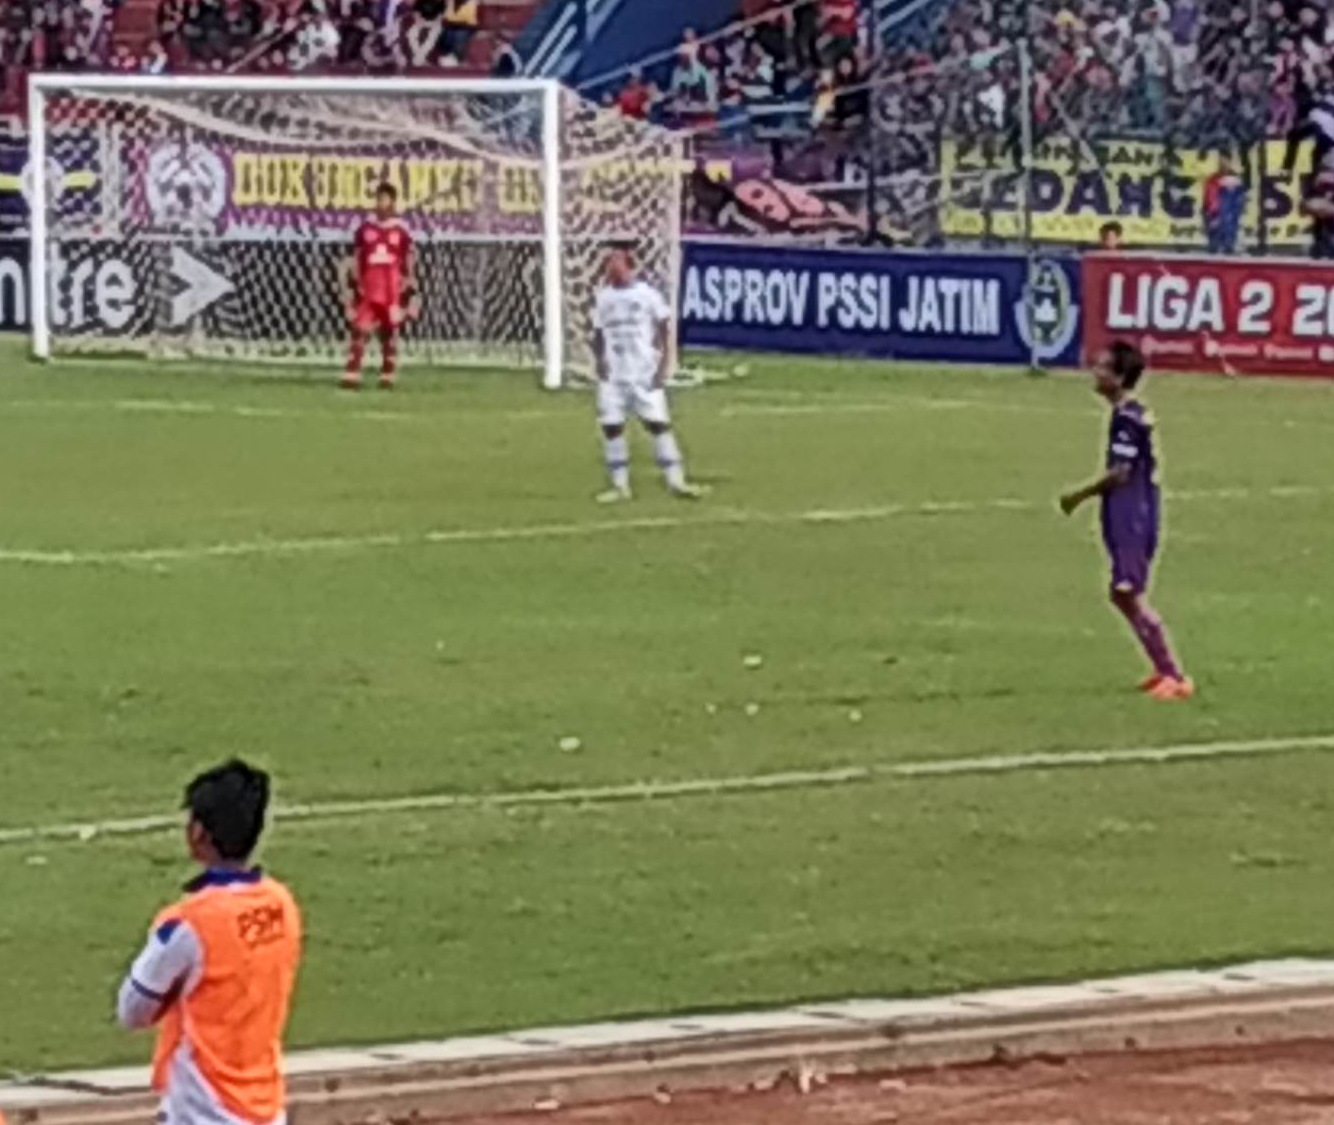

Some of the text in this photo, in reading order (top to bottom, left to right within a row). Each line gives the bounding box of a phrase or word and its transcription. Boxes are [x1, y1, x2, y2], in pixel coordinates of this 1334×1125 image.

[682, 265, 1000, 334] ASPROV PSSI JATIM
[1106, 272, 1224, 331] LIGA
[1237, 279, 1274, 333] 2
